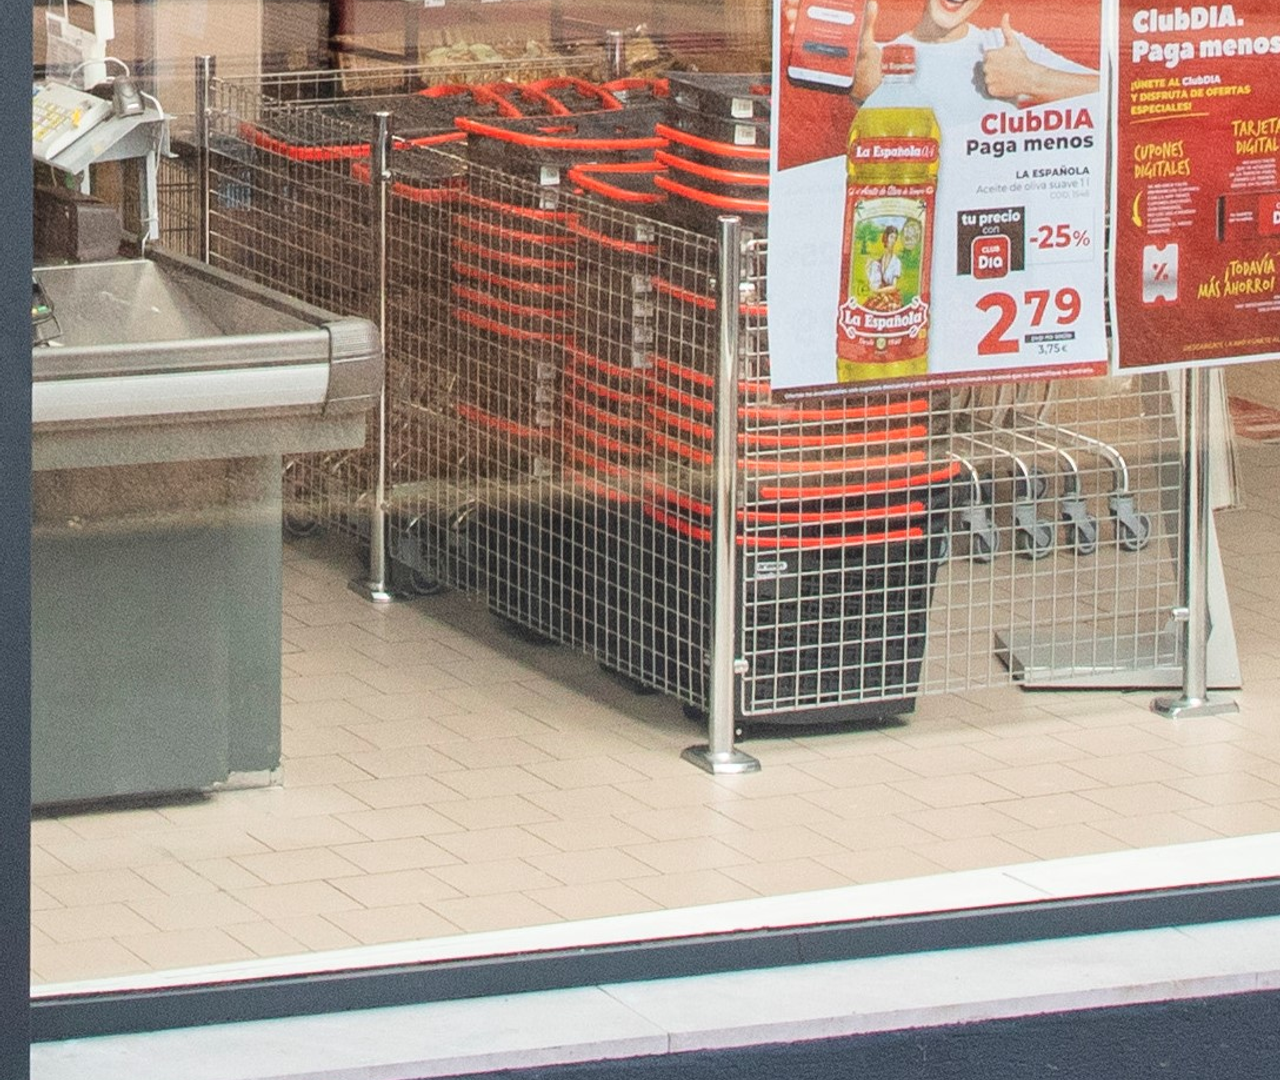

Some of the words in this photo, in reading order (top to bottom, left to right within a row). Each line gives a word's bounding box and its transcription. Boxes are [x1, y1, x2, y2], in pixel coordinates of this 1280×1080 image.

[1132, 5, 1244, 33] ClubDIA.
[1132, 40, 1194, 69] Paga
[1167, 78, 1181, 88] AL
[1131, 93, 1139, 103] Y
[1140, 89, 1189, 102] DISFRUTA
[1190, 88, 1204, 98] DE
[1206, 85, 1251, 97] OFERTAS
[981, 109, 1094, 135] ClubDIA
[856, 146, 871, 158] La
[966, 139, 1017, 158] Paga
[1024, 135, 1094, 152] menos
[1134, 140, 1184, 162] CUPONES
[1236, 137, 1279, 156] DIGITAL
[1016, 170, 1030, 180] LA
[1032, 164, 1090, 178] ESPAÑOLA
[1134, 157, 1191, 180] DIGITALES
[976, 184, 1007, 195] Aceite
[1009, 182, 1021, 193] de
[1024, 181, 1047, 192] oliva
[1049, 179, 1079, 189] suave
[961, 213, 977, 226] tu
[979, 209, 1021, 227] precio
[982, 225, 1000, 235] con
[1029, 223, 1091, 250] -25%
[1197, 275, 1221, 300] MÁS
[845, 309, 861, 327] La
